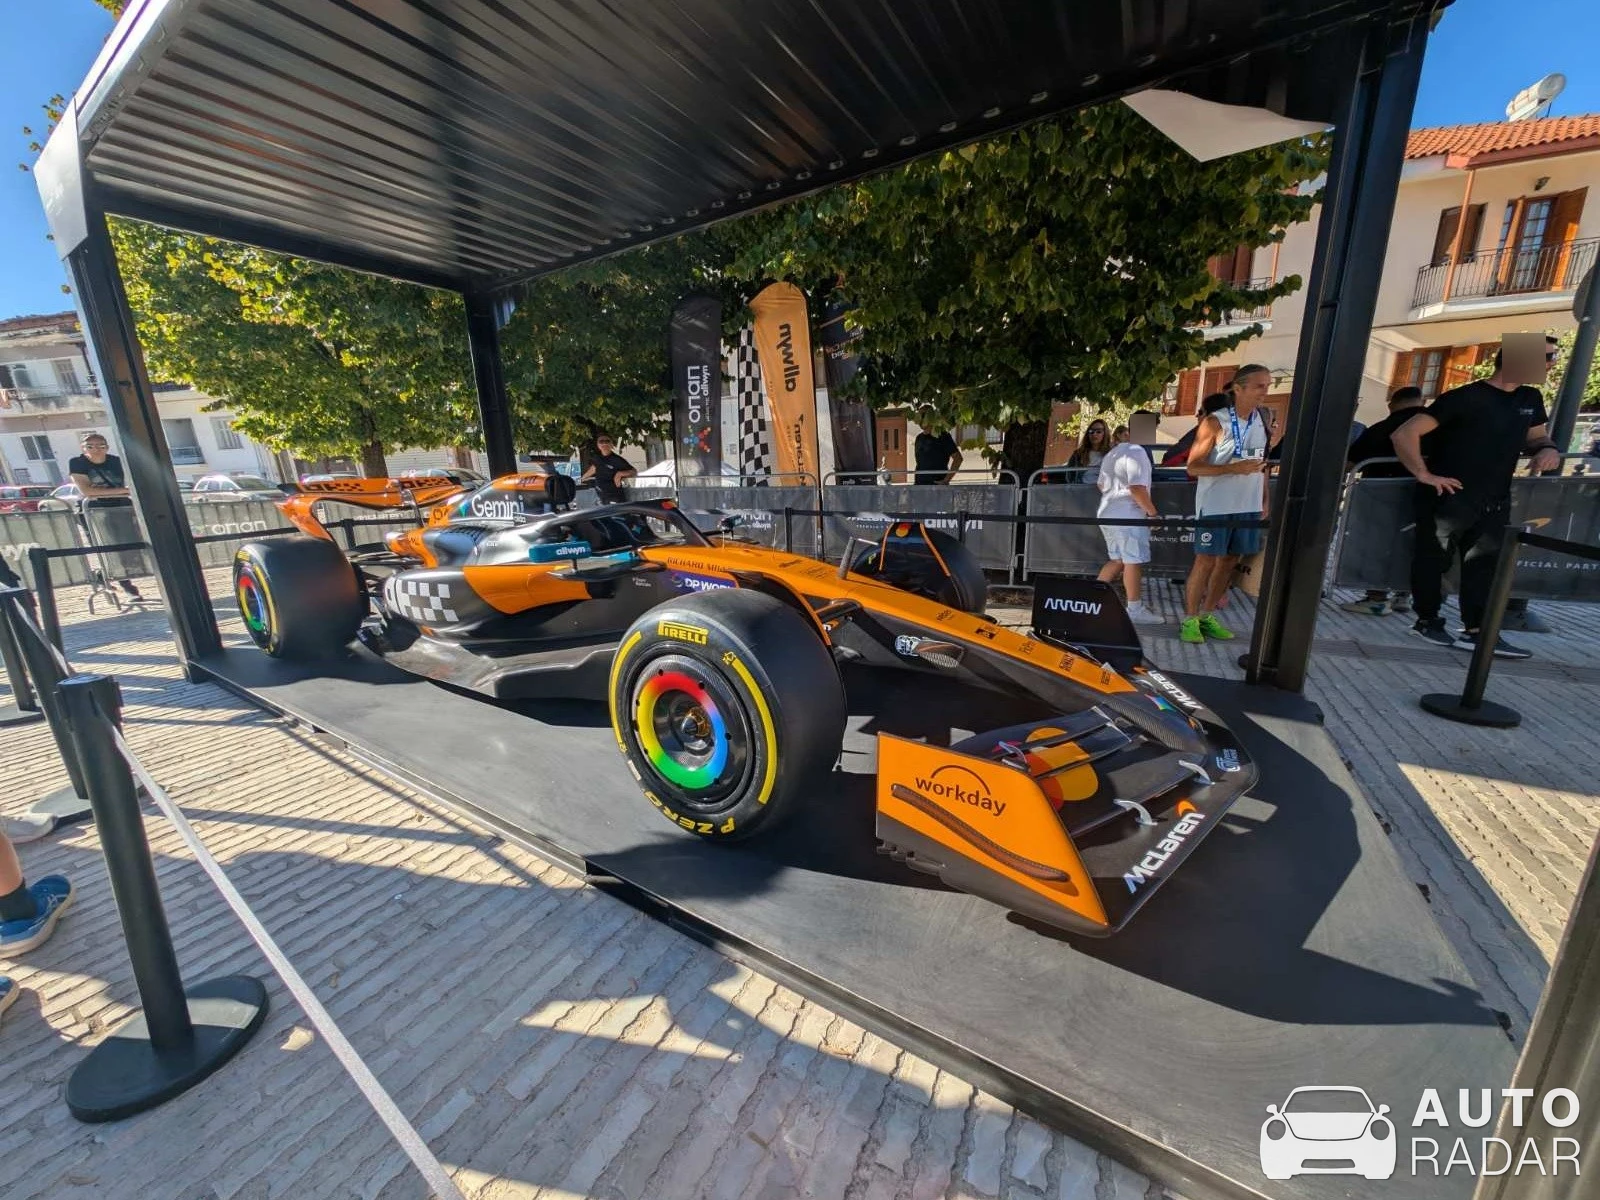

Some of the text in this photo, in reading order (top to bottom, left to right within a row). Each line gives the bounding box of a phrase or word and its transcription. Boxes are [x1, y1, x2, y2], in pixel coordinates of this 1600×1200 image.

[701, 365, 711, 396] allwyn
[472, 494, 525, 519] Gemini
[556, 547, 586, 556] allwyn
[667, 557, 705, 570] RICHARD
[1566, 562, 1600, 570] PART
[684, 578, 700, 588] DP
[1044, 597, 1102, 615] ARROW
[658, 620, 709, 645] PIRELLI
[1147, 670, 1204, 710] McLaren
[915, 777, 1006, 817] workday
[643, 791, 736, 834] P ZERO
[1123, 812, 1206, 894] McLaren
